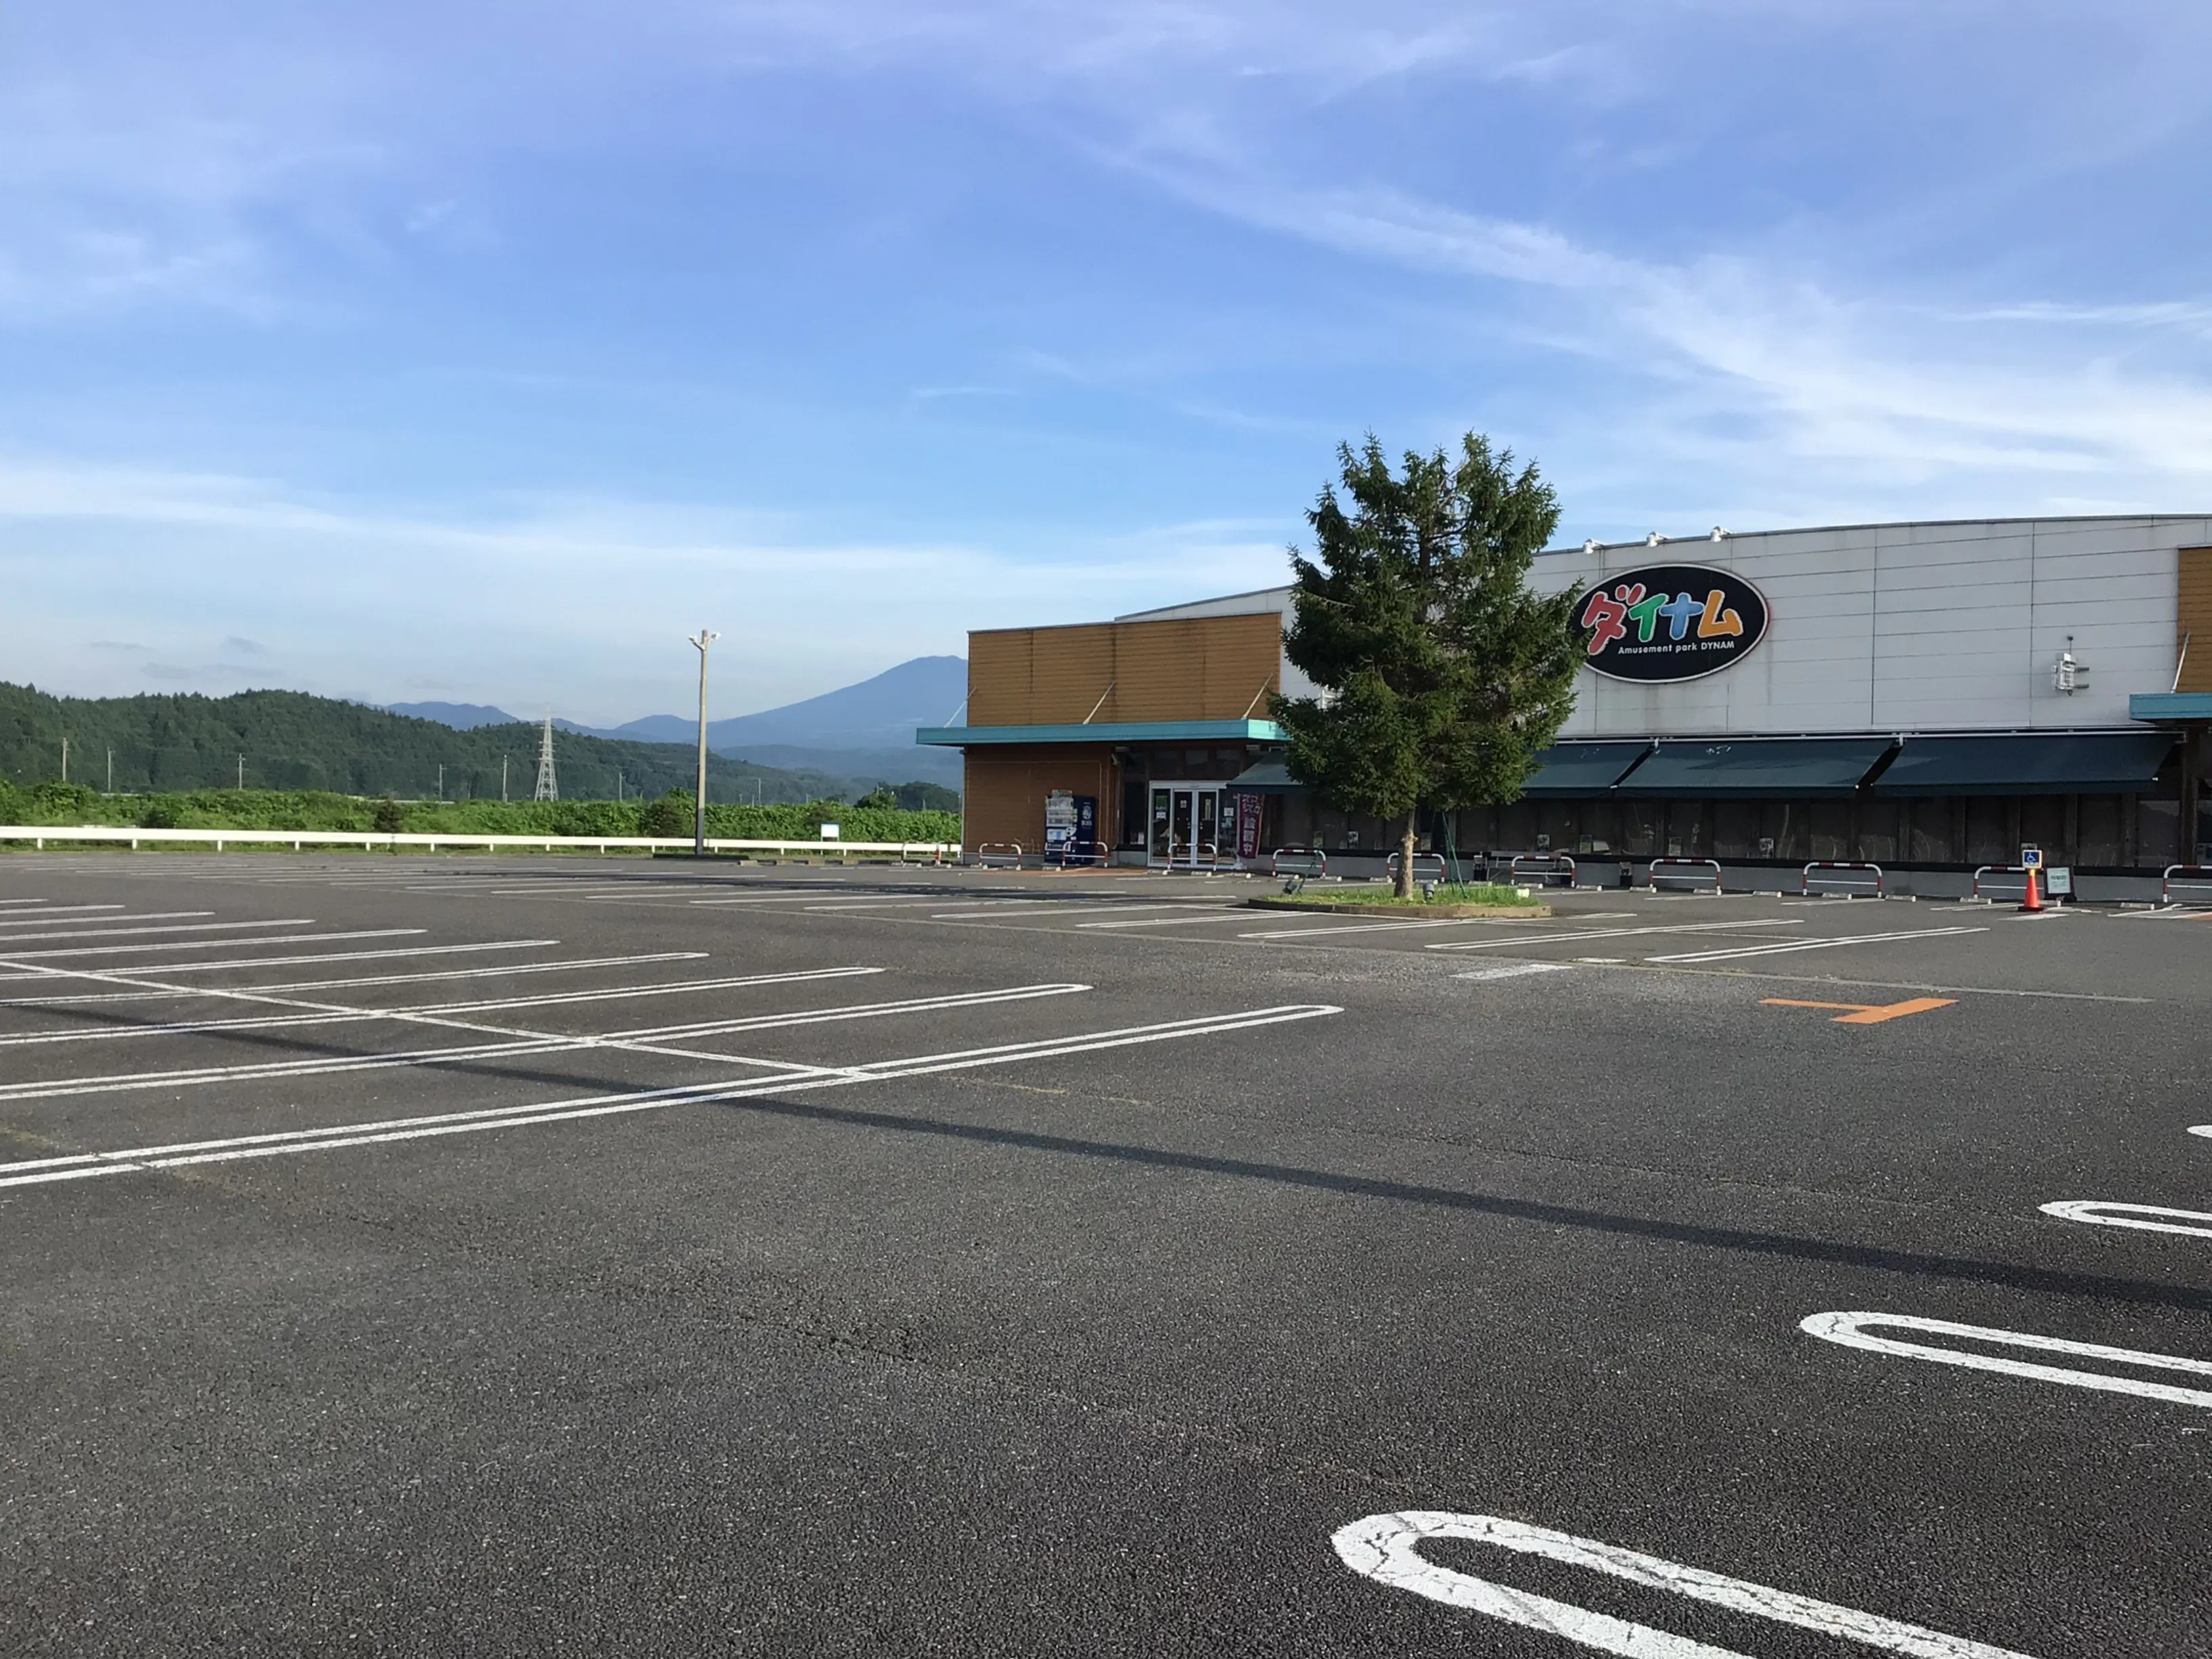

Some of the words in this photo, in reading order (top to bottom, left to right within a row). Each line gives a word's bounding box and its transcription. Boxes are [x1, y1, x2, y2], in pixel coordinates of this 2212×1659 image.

[1581, 583, 1744, 655] ダイナム
[1618, 644, 1673, 655] Amusement
[1675, 642, 1698, 654] park
[1700, 640, 1735, 651] DYNAM
